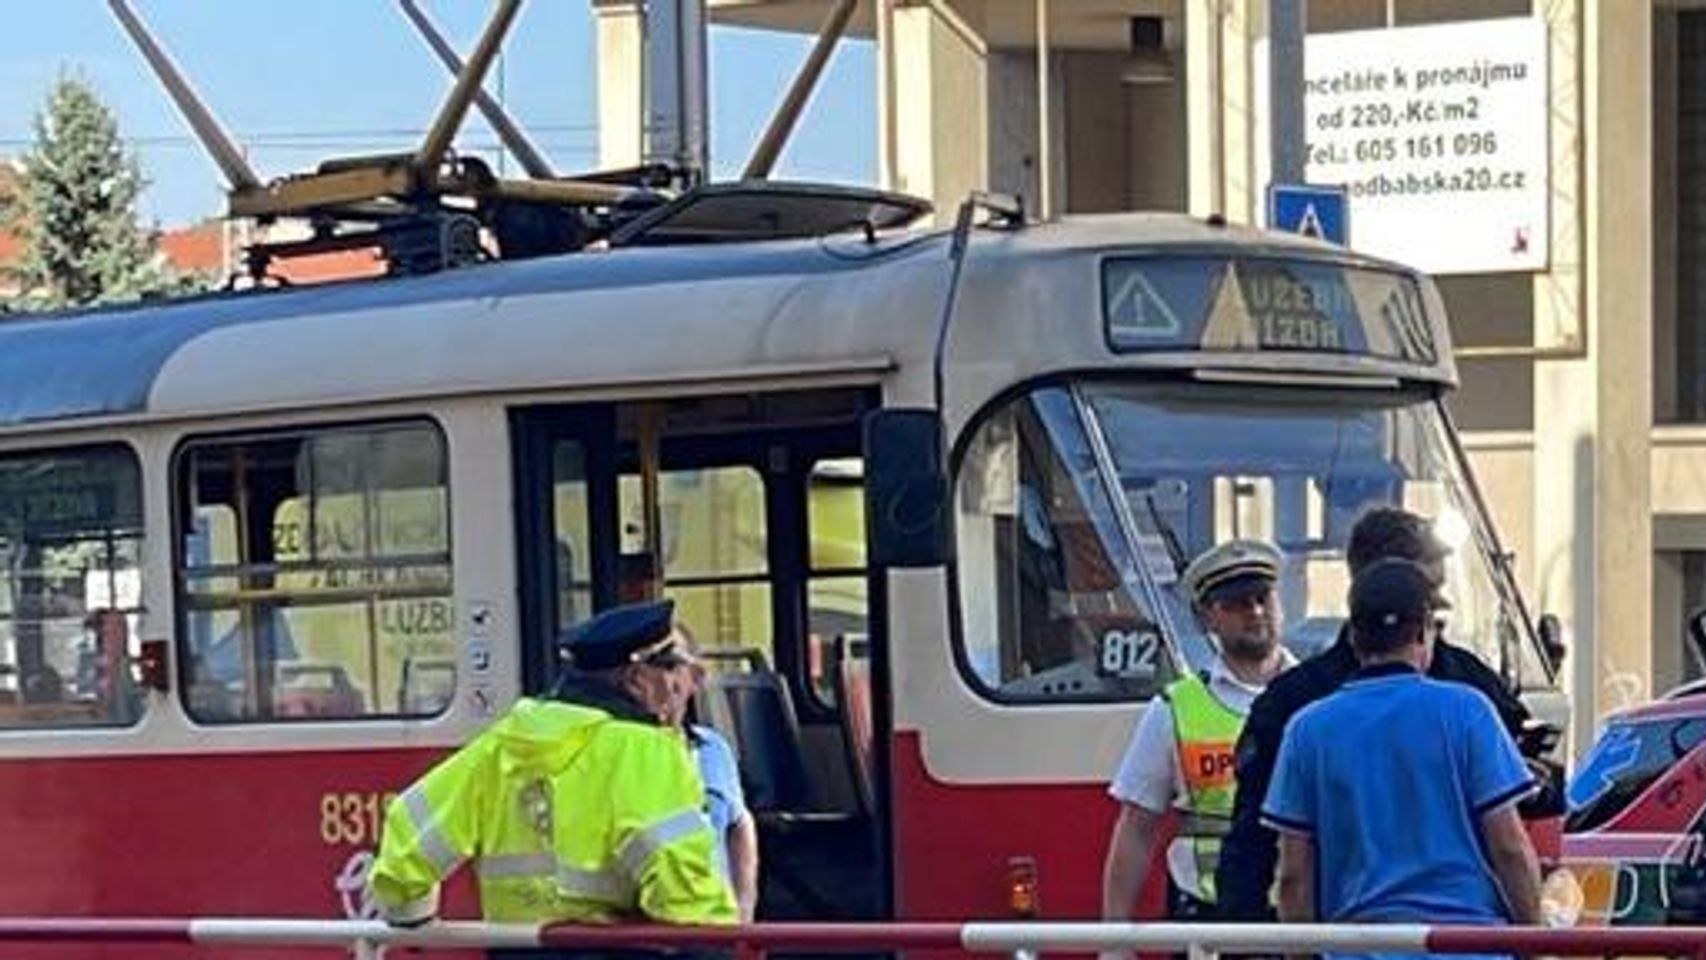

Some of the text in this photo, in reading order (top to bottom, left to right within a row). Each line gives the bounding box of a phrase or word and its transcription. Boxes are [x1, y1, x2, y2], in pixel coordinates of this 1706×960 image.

[1393, 67, 1408, 90] k
[1316, 106, 1343, 130] od
[1354, 138, 1397, 162] 605
[1406, 133, 1446, 158] 161
[1453, 130, 1498, 156] 096
[1103, 630, 1158, 672] 812
[321, 791, 397, 844] 831
